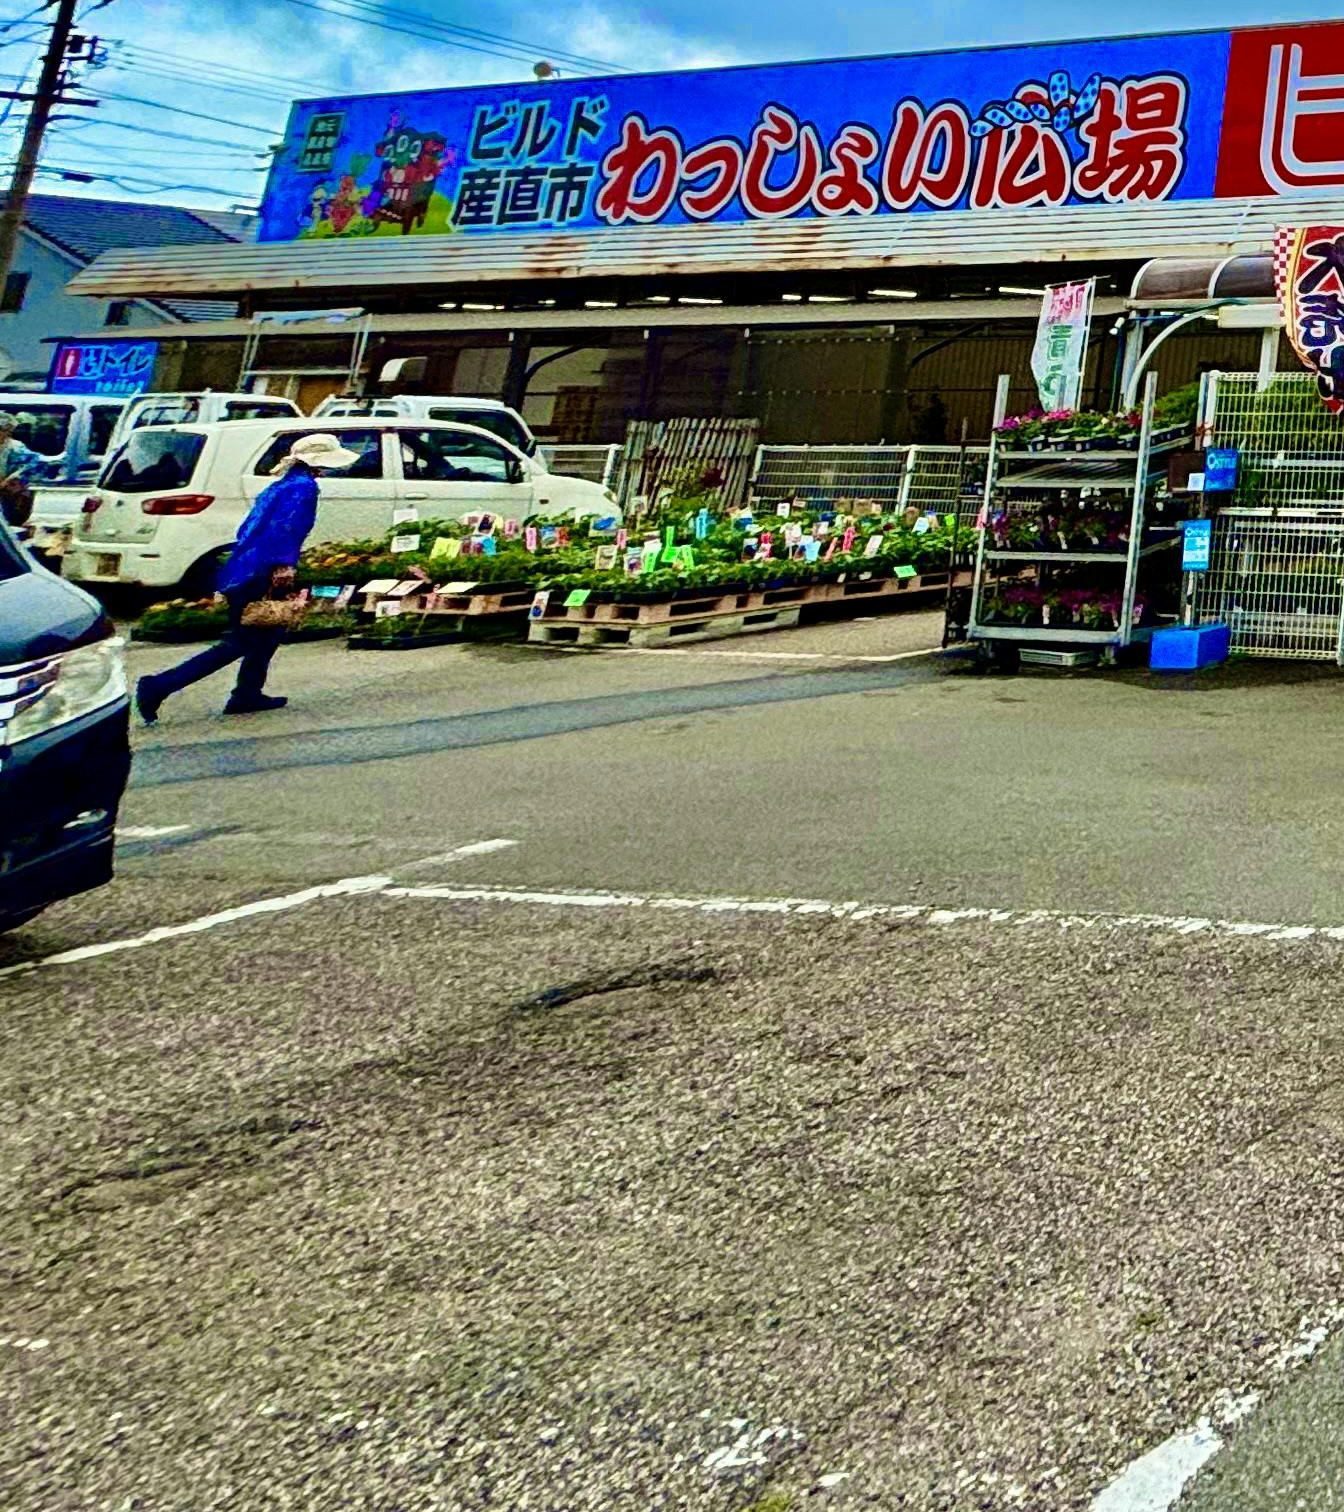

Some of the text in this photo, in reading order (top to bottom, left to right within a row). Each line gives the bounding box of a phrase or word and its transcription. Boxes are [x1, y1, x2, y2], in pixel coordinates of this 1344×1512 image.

[468, 93, 609, 162] ビルド
[594, 73, 1192, 226] わっしょい広場
[448, 164, 599, 230] 産直市
